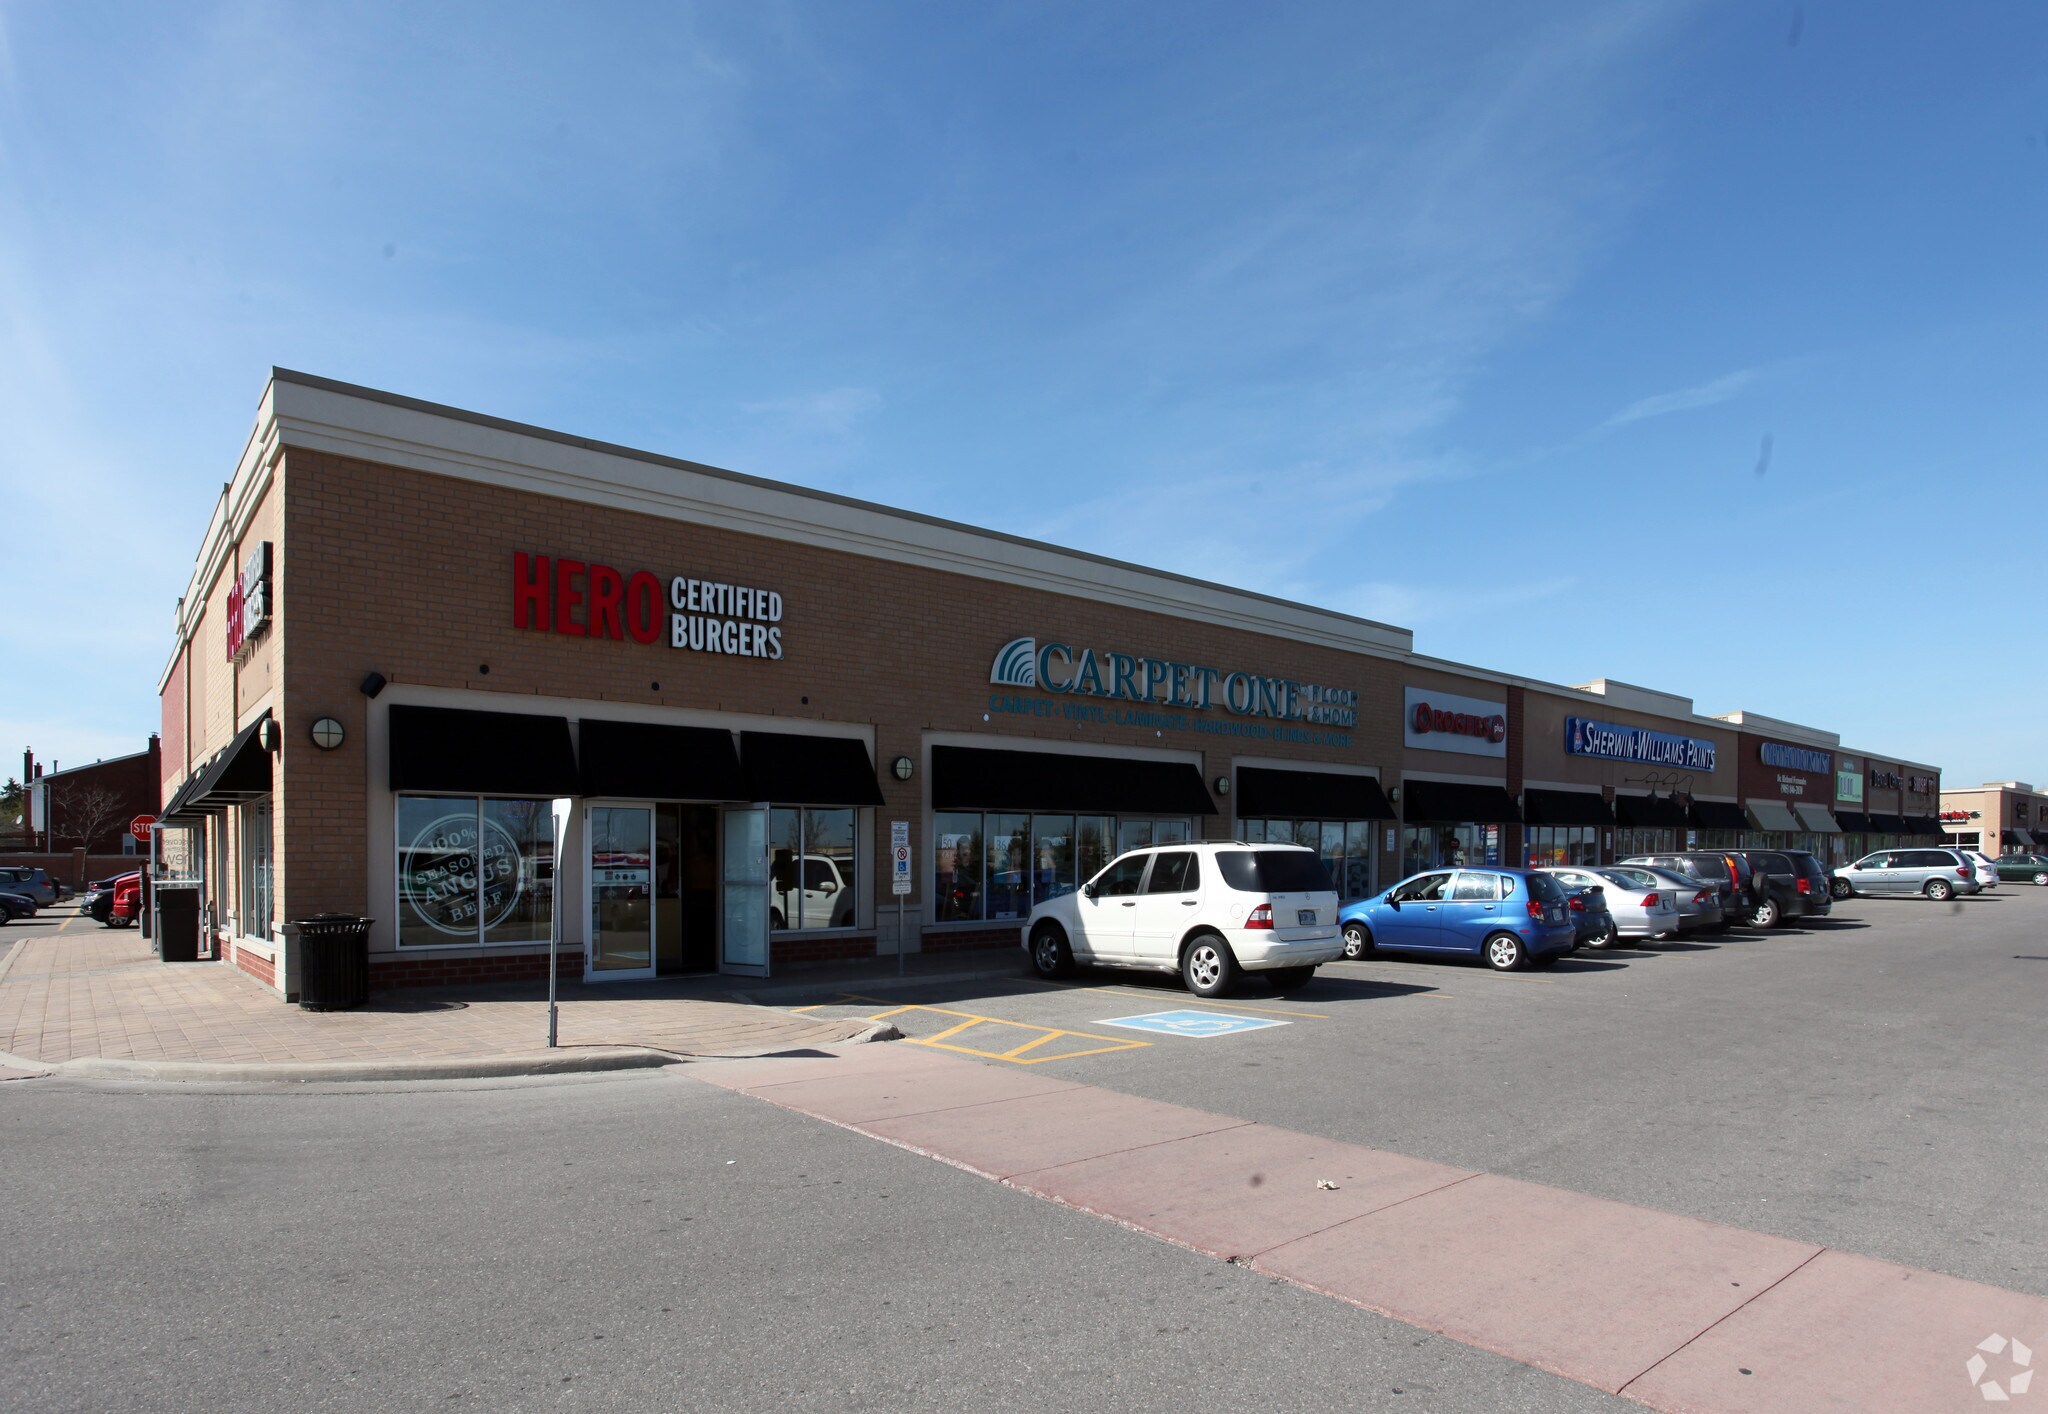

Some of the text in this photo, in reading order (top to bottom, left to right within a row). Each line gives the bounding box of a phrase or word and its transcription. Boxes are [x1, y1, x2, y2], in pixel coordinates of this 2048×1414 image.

[513, 551, 663, 644] HERO
[671, 576, 783, 622] CERTIFIED
[671, 613, 784, 660] BURGERS
[1036, 642, 1302, 720] CARPET ONE
[1310, 685, 1359, 708] FLOOR
[989, 694, 1055, 718] CARPET
[1062, 703, 1109, 724] VINYL
[1116, 708, 1187, 733] LAMINATE
[1195, 719, 1267, 740] HARDWOOD
[1274, 727, 1310, 744] BLINDS
[1324, 733, 1353, 748] MORE
[1434, 709, 1490, 738] ROGERS
[1585, 722, 1716, 769] SHERWIN-WILLIAMS PAINTS
[133, 823, 151, 833] STO
[428, 826, 477, 854] 100%
[424, 857, 513, 905] ANGUS
[449, 891, 504, 923] BEEF
